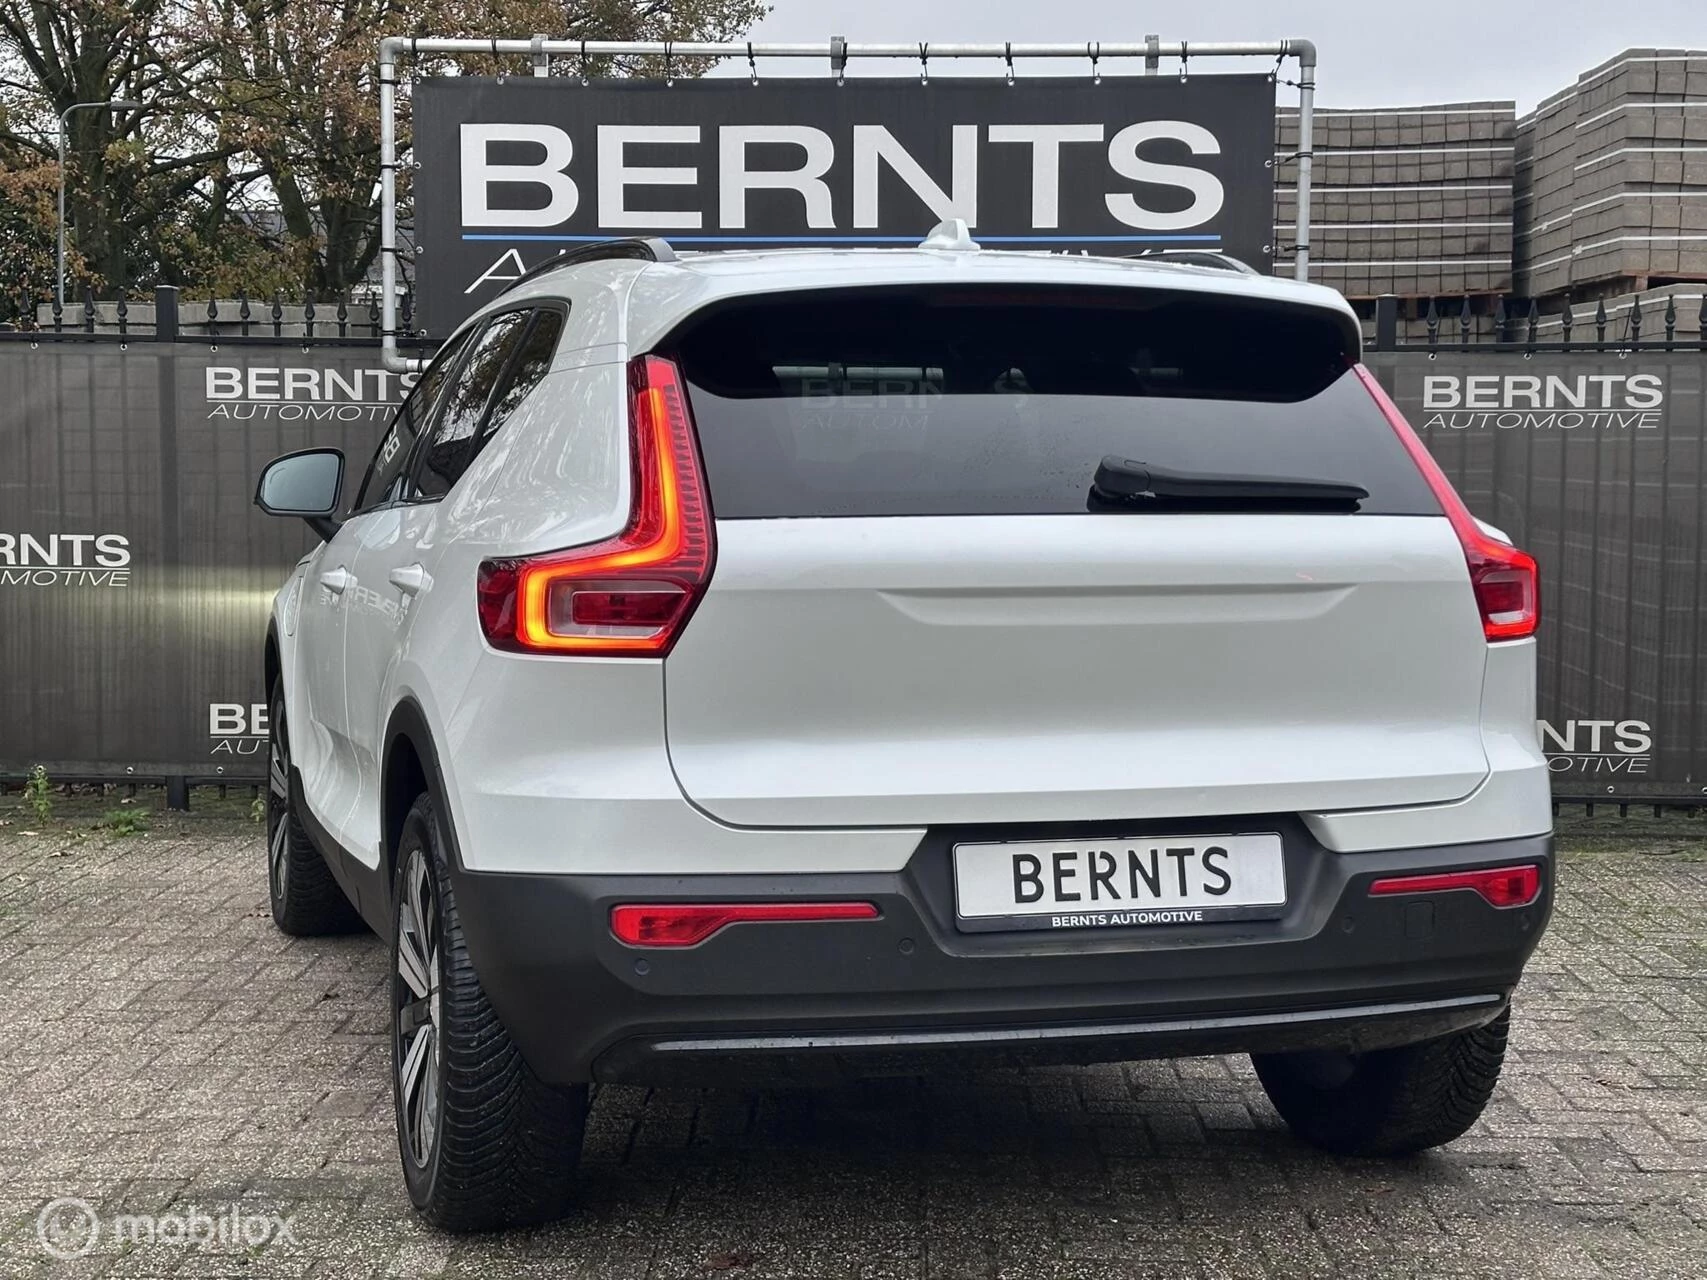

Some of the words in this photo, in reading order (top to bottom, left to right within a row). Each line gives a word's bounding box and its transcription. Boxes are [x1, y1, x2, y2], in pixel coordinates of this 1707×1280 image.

[459, 120, 1224, 231] BERNTS
[1423, 374, 1664, 409] BERNTS
[207, 403, 398, 421] AUTOMOTI
[1423, 412, 1663, 429] AUTOMOTIVE
[0, 570, 131, 587] MOTIVE
[1536, 719, 1652, 753] NTS
[1547, 756, 1651, 773] OTIVE
[1012, 846, 1232, 904] BERNTS
[1051, 915, 1107, 928] BERNTS
[1110, 911, 1203, 925] AUTOMOTIVE
